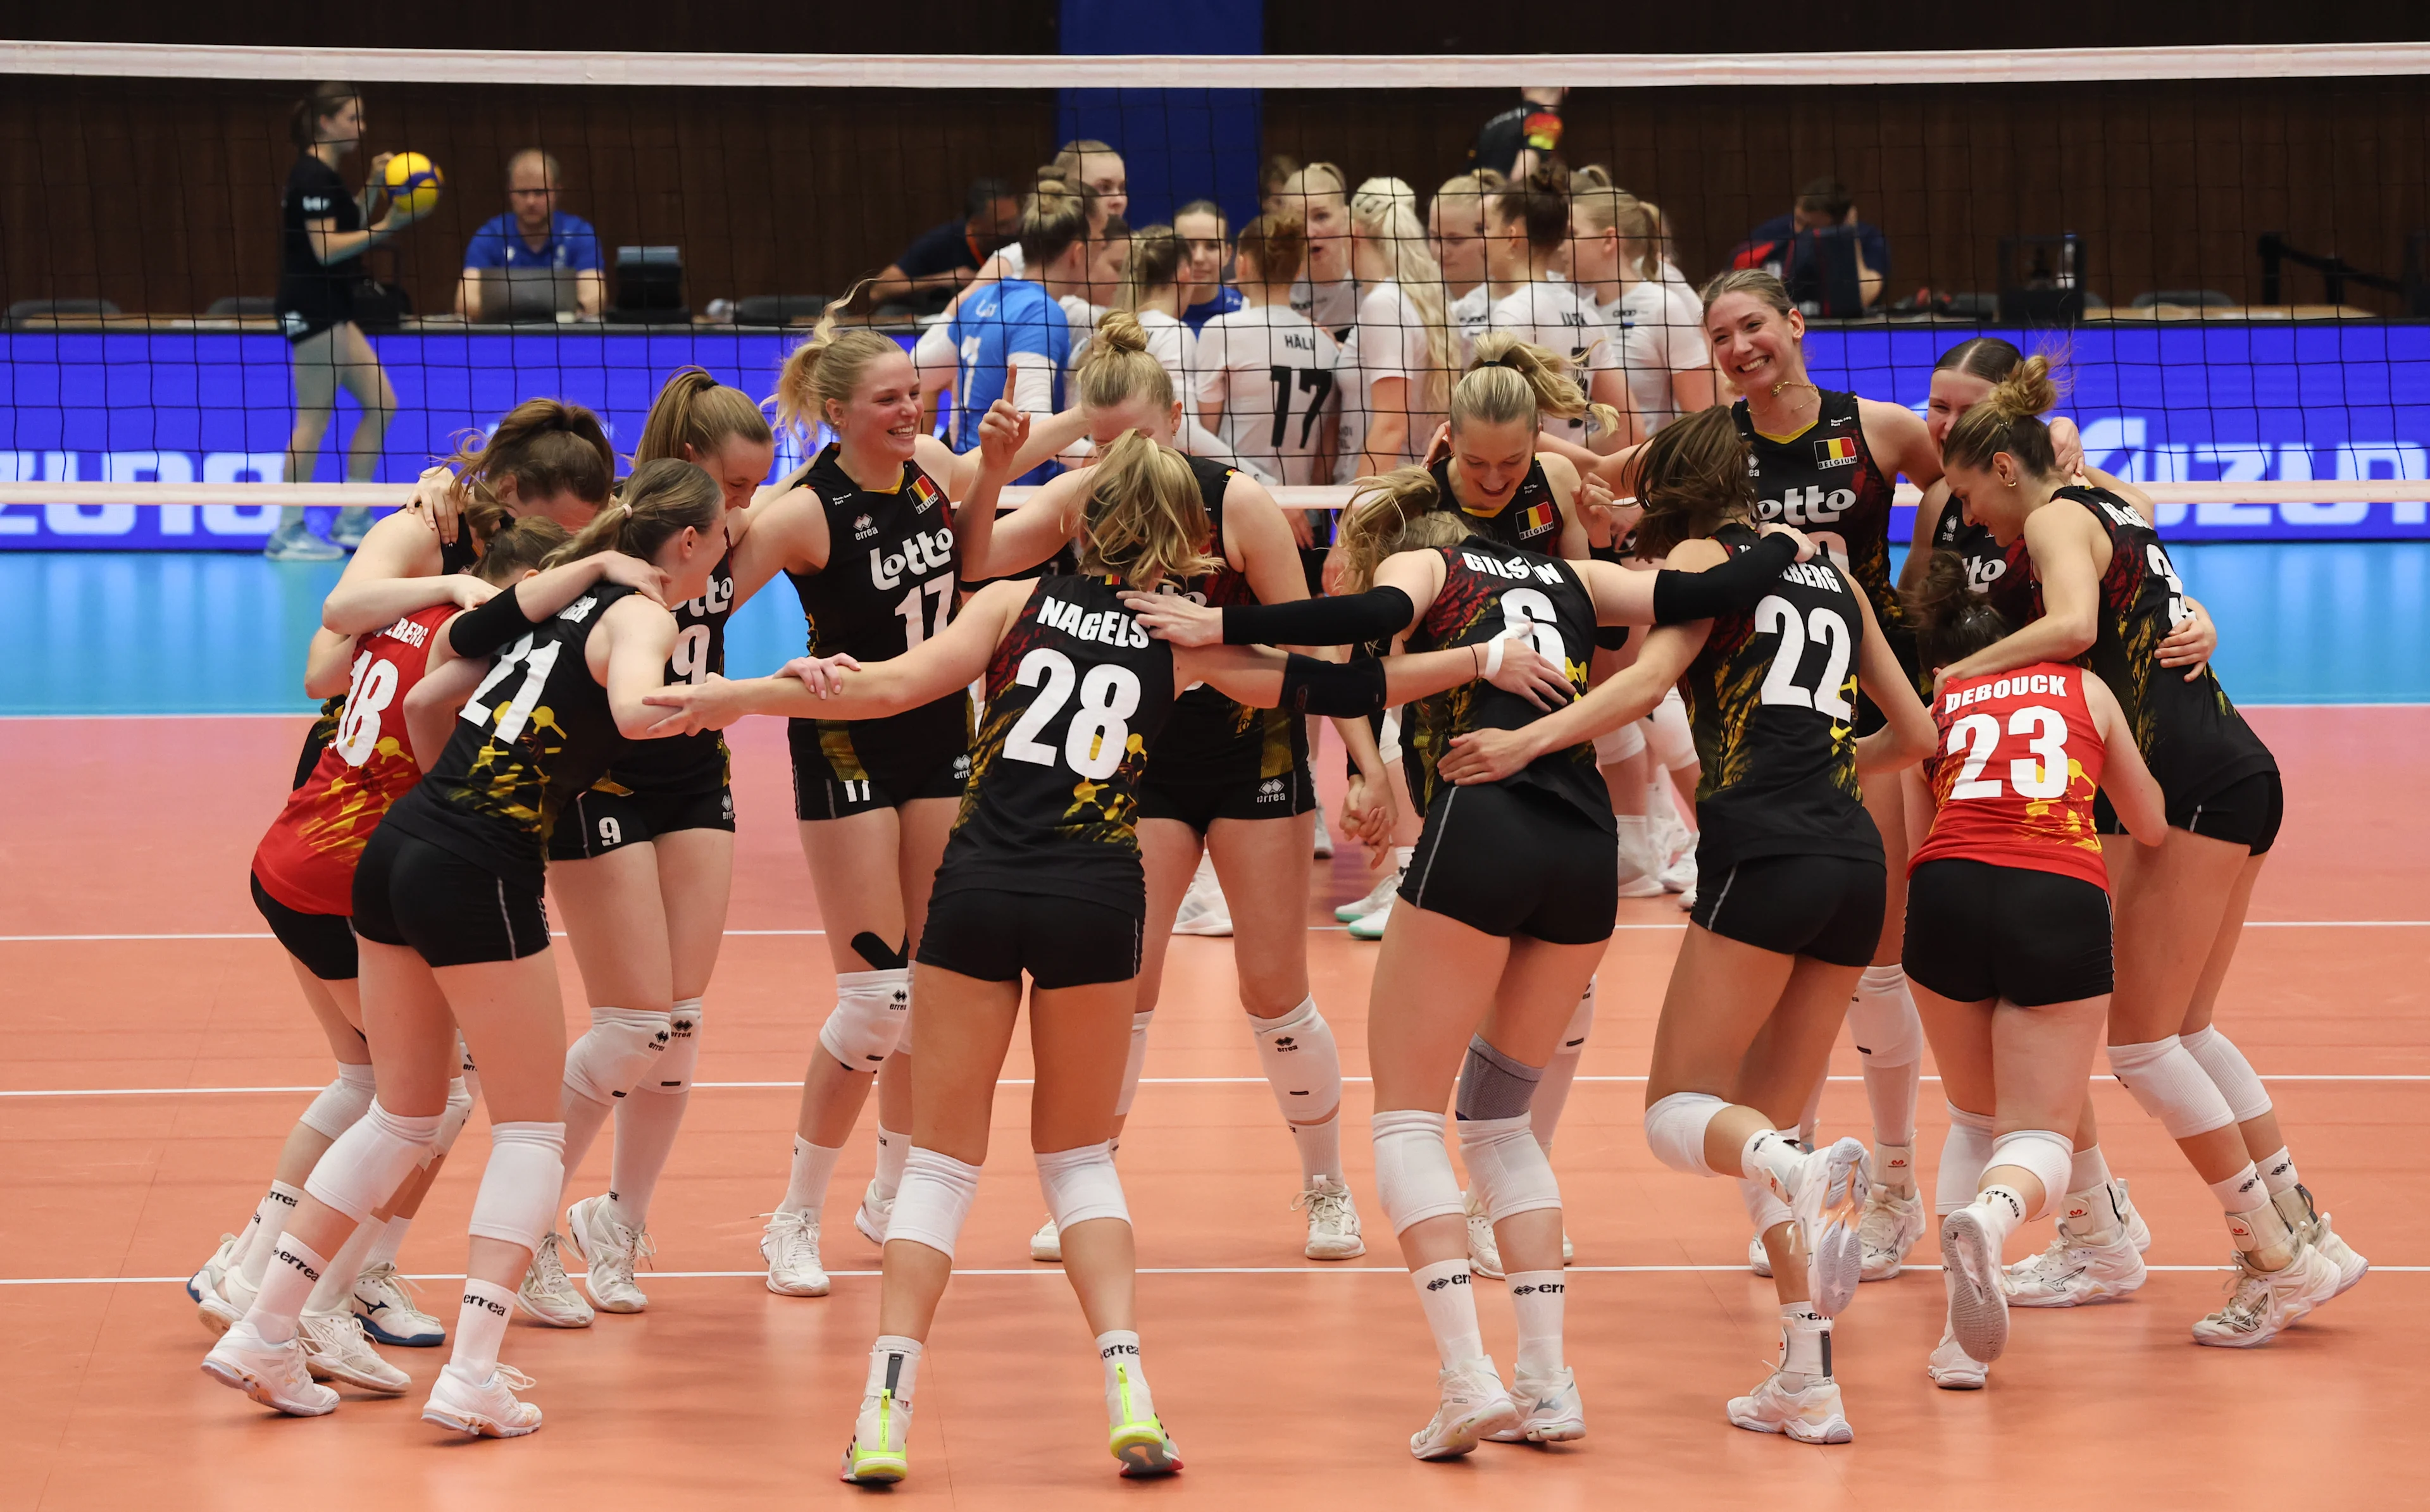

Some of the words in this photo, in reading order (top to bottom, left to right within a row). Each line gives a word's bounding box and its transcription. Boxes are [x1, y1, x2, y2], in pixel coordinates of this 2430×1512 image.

[1271, 365, 1332, 449] 17
[1818, 457, 1857, 469] BELGIUM
[855, 526, 878, 540] errea
[1520, 523, 1554, 540] BELGIUM
[1748, 484, 1857, 529] otto
[869, 527, 954, 590] lotto
[895, 570, 954, 651] 17
[1037, 595, 1150, 649] NAGELS
[1500, 588, 1566, 671] 6
[671, 624, 711, 685] 9
[1755, 595, 1852, 723] 22
[328, 649, 399, 767] 18
[459, 631, 563, 745] 21
[1002, 647, 1142, 780] 28
[1945, 674, 2067, 715] DEBOUCK
[1945, 705, 2069, 800] 23
[1256, 793, 1285, 803] errea
[599, 816, 621, 847] 9
[280, 1251, 320, 1282] errea
[463, 1294, 506, 1317] errea
[1103, 1344, 1140, 1358] errea
